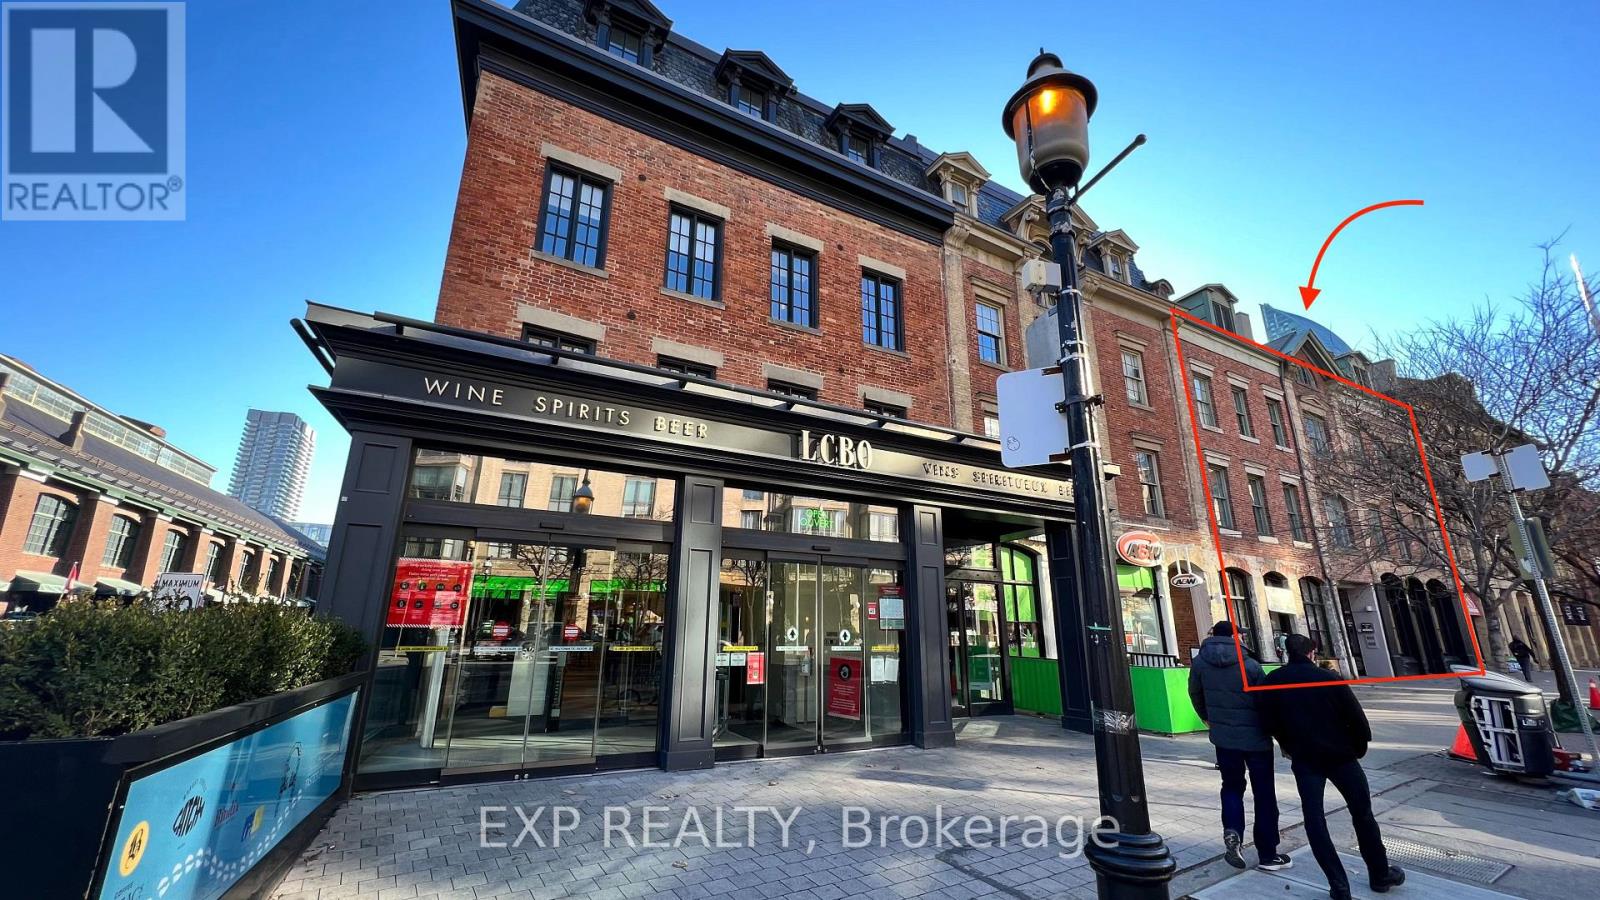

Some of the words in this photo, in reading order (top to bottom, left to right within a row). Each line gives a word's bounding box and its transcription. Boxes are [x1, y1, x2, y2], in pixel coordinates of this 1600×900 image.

[424, 377, 504, 406] WINE
[535, 396, 630, 426] SPIRITS
[654, 416, 708, 440] BEER
[801, 429, 873, 470] LCBO
[161, 579, 201, 588] MAXIMUM
